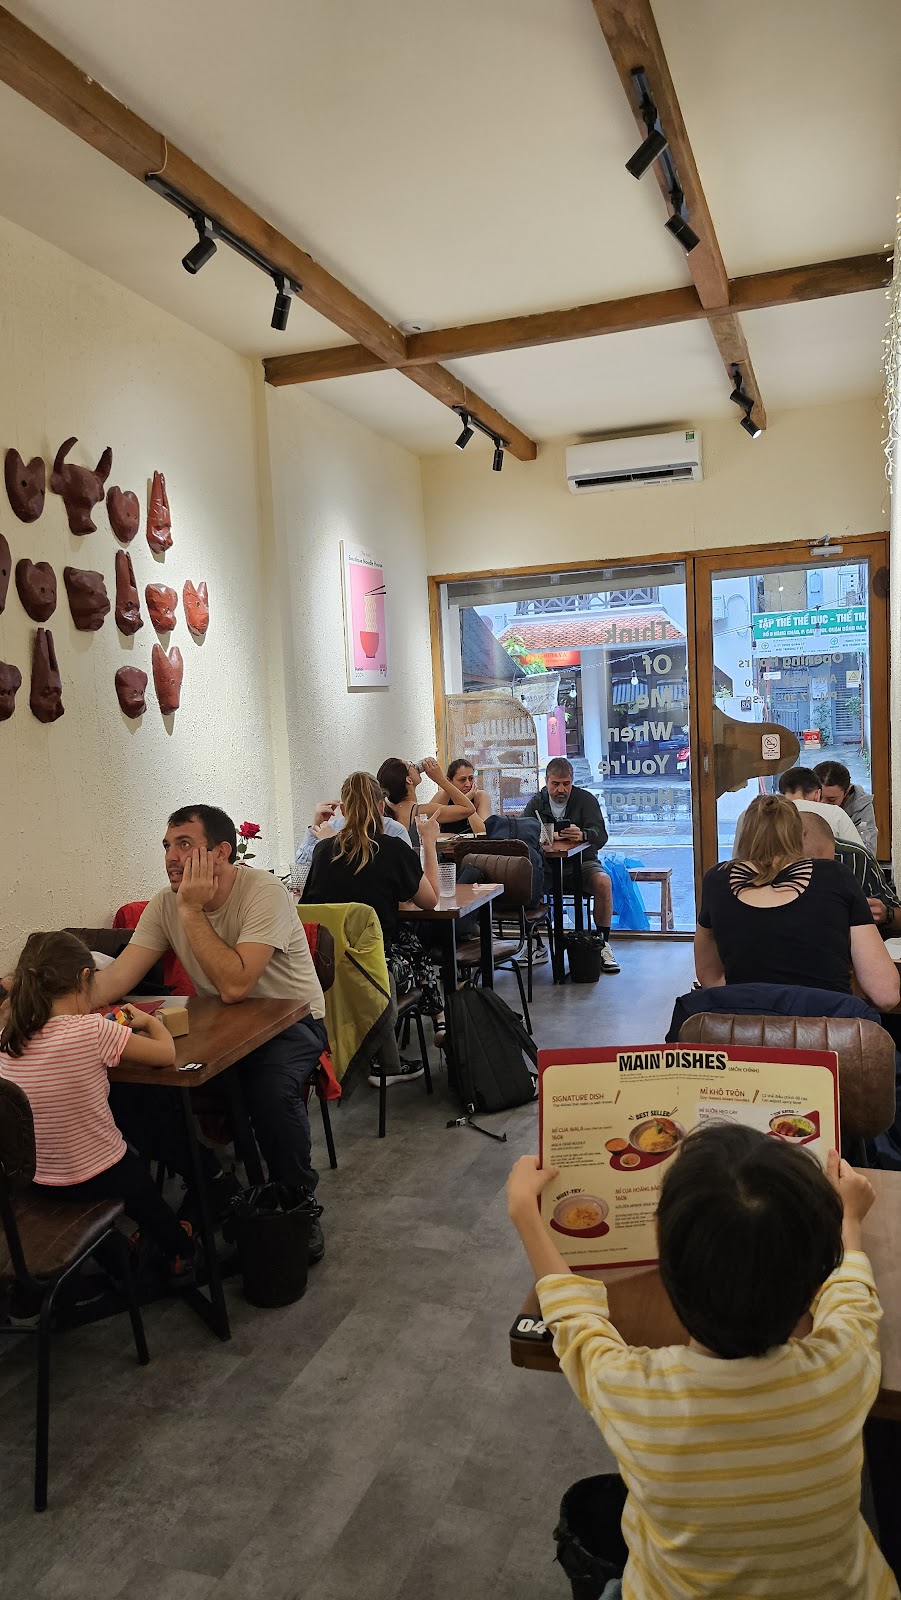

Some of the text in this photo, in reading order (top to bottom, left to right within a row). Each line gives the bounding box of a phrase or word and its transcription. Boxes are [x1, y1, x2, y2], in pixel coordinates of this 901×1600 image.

[758, 617, 774, 630] TẬP
[619, 1053, 660, 1072] MAIN
[665, 1052, 727, 1070] DISHES
[552, 1093, 604, 1102] SIGNATURE DISH
[635, 1109, 670, 1120] BEST SELLER
[556, 1188, 582, 1200] MUST-TRY
[516, 1318, 547, 1334] 04
